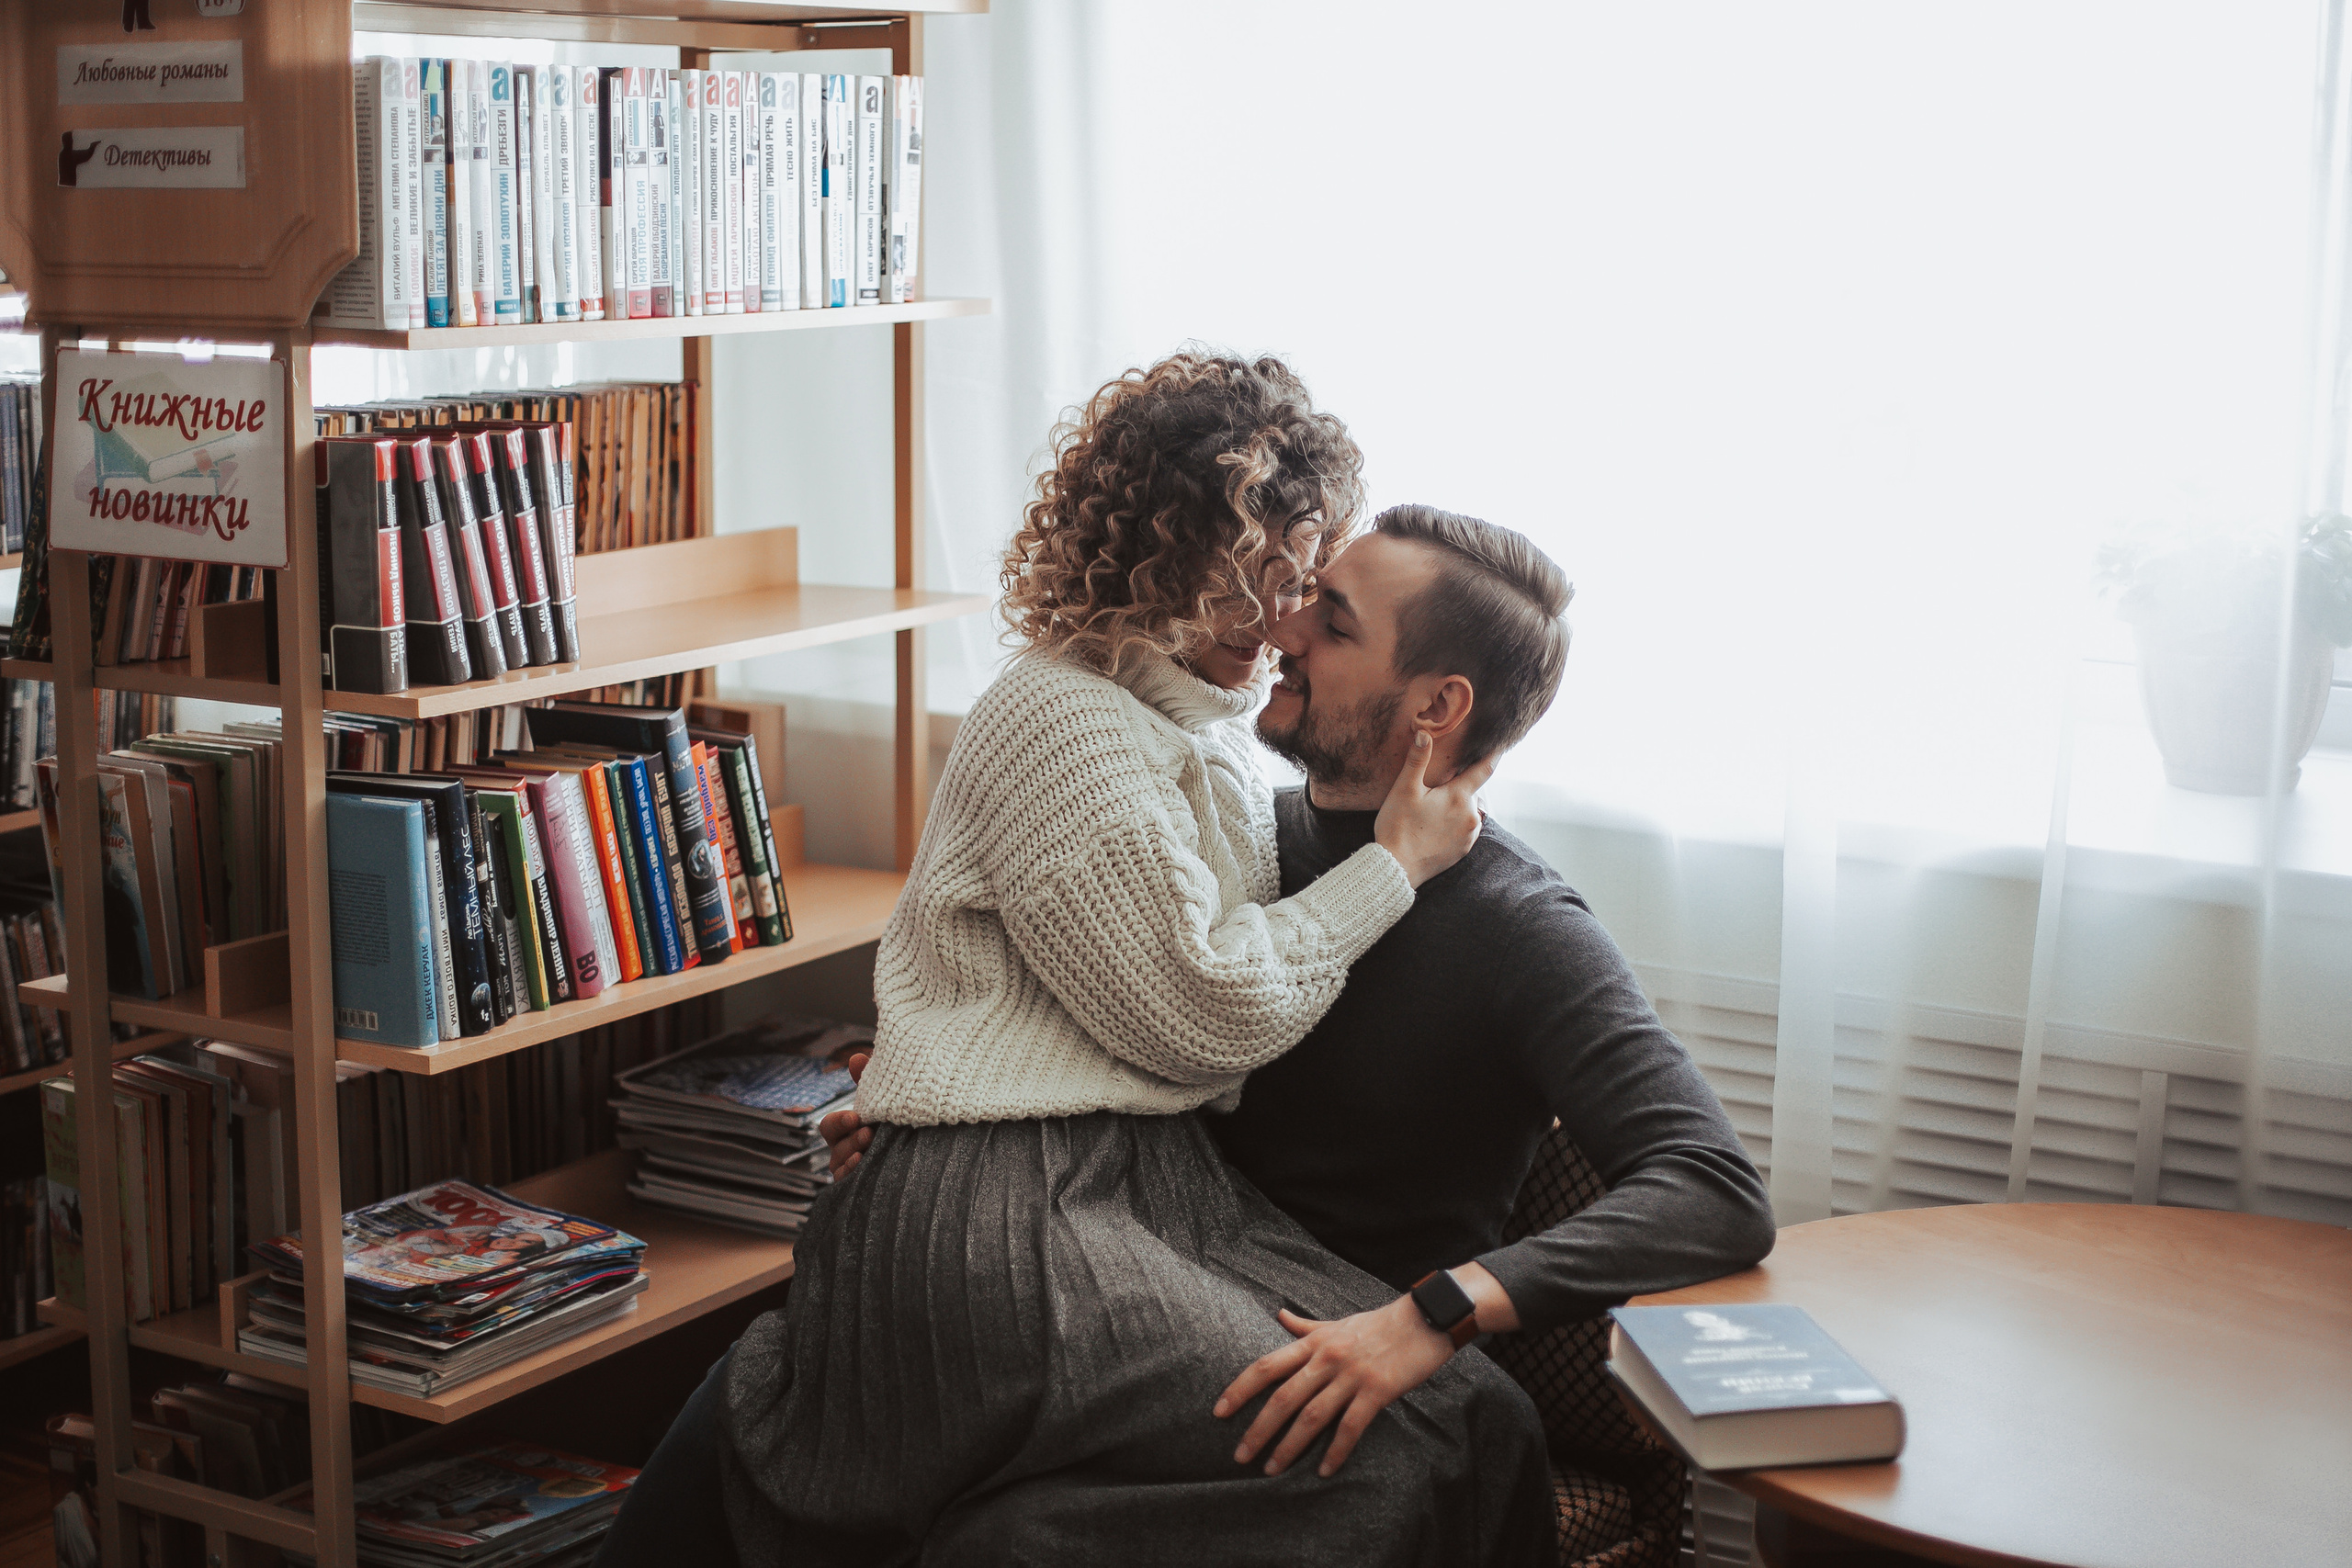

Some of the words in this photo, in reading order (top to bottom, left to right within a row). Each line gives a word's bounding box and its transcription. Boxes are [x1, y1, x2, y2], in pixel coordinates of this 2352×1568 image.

[74, 58, 156, 85] Любовные
[161, 62, 229, 87] романы
[408, 107, 417, 167] ЗАБЫТЫЕ
[497, 109, 510, 165] ДРЕБЕЗГИ
[710, 113, 718, 135] ЧУДУ
[765, 115, 774, 141] РЕЧЬ
[785, 118, 793, 147] ЖИТЬ
[104, 144, 212, 172] Детективы
[590, 144, 595, 156] НА
[765, 144, 775, 186] ПРЯМАЯ
[810, 140, 818, 152] НА
[391, 163, 401, 210] АНГЕЛИНА
[434, 170, 446, 193] ДНИ
[560, 158, 570, 195] ТРЕТИЙ
[589, 159, 597, 203] РИСУНКИ
[710, 146, 718, 220] ПРИКОСНОВЕНИЕ
[409, 183, 418, 235] ВЕЛИКИЕ
[435, 197, 447, 237] ДНЯМИ
[499, 173, 511, 240] ЗОЛОТУХИН
[562, 202, 571, 247] КОЗАКОВ
[637, 180, 647, 254] ПРОФЕССИЯ
[650, 184, 660, 242] ОБОДЗИНСКИЙ
[765, 195, 775, 243] ФИЛАТОВ
[392, 217, 401, 251] ВУЛЬФ
[435, 239, 445, 254] ЗА
[590, 209, 598, 251] КОЗАКОВ
[392, 254, 401, 299] ВИТАЛИЙ
[410, 244, 419, 298] КОМИКИ:
[435, 256, 446, 291] ЛЕТЯТ
[500, 244, 513, 296] ВАЛЕРИЙ
[639, 257, 647, 283] МОЯ
[652, 243, 661, 279] ВАЛЕРИЙ
[673, 244, 682, 282] АНАТОЛИЙ
[730, 249, 739, 286] АНДРЕЙ
[766, 246, 776, 285] ЛЕОНИД
[78, 378, 266, 442] Книжные
[88, 487, 250, 542] новинки
[424, 481, 435, 525] БИОГРАФИИ
[433, 528, 446, 558] ИЛЬЯ
[556, 513, 567, 557] ВЯЧЕСЛАВ
[566, 509, 574, 555] ЕКАТЕРИНА
[390, 533, 399, 581] ЛЕОНИД
[494, 518, 504, 552] ИГОРЬ
[501, 552, 515, 600] ТАЛЬКОВ
[526, 514, 537, 549] ИГОРЬ
[532, 549, 546, 597] ТАЛЬКОВ
[438, 559, 456, 615] ГЛАЗУНОВ
[561, 556, 572, 598] ТИХОНОВ
[391, 582, 401, 623] БЫКОВ
[537, 608, 548, 633] ПУТЬ
[398, 630, 406, 659] АТЫ-
[447, 623, 458, 653] ГЕНИЙ
[454, 620, 467, 663] РУССКИЙ
[485, 618, 496, 649] ЗВЕЗДЫ
[508, 613, 518, 637] ПУТЬ
[514, 607, 528, 656] КРЕСТНЫЙ
[390, 631, 400, 674] БАТЫ...
[654, 771, 669, 804] БУНТ
[460, 824, 472, 858] ЛЕС
[470, 812, 481, 852] ПУШКИН
[525, 817, 537, 844] МОЙ
[531, 845, 544, 875] МУЖ
[561, 781, 578, 833] ТЕРРИ
[571, 835, 594, 911] ПРАТЧЕТТ
[571, 784, 588, 832] ТЕРРИ
[582, 835, 603, 909] ПРАТЧЕТТ
[434, 850, 443, 888] Татьяна
[437, 890, 447, 921] Томах
[464, 862, 481, 940] ТЕМНЫЙ
[441, 929, 450, 953] ИМЯ
[537, 875, 557, 939] ВЛАДИМИР
[549, 938, 566, 981] ЛЕНИН
[421, 943, 432, 987] КЕРУАК
[496, 932, 506, 966] ШАРП
[507, 931, 529, 1007] ЖЕЛЯЗНЫ
[576, 949, 599, 984] ВО
[445, 954, 455, 992] ТВОЕГО
[503, 975, 511, 994] ТОМ
[424, 987, 435, 1021] ДЖЕК
[447, 993, 458, 1026] ВОЛКА
